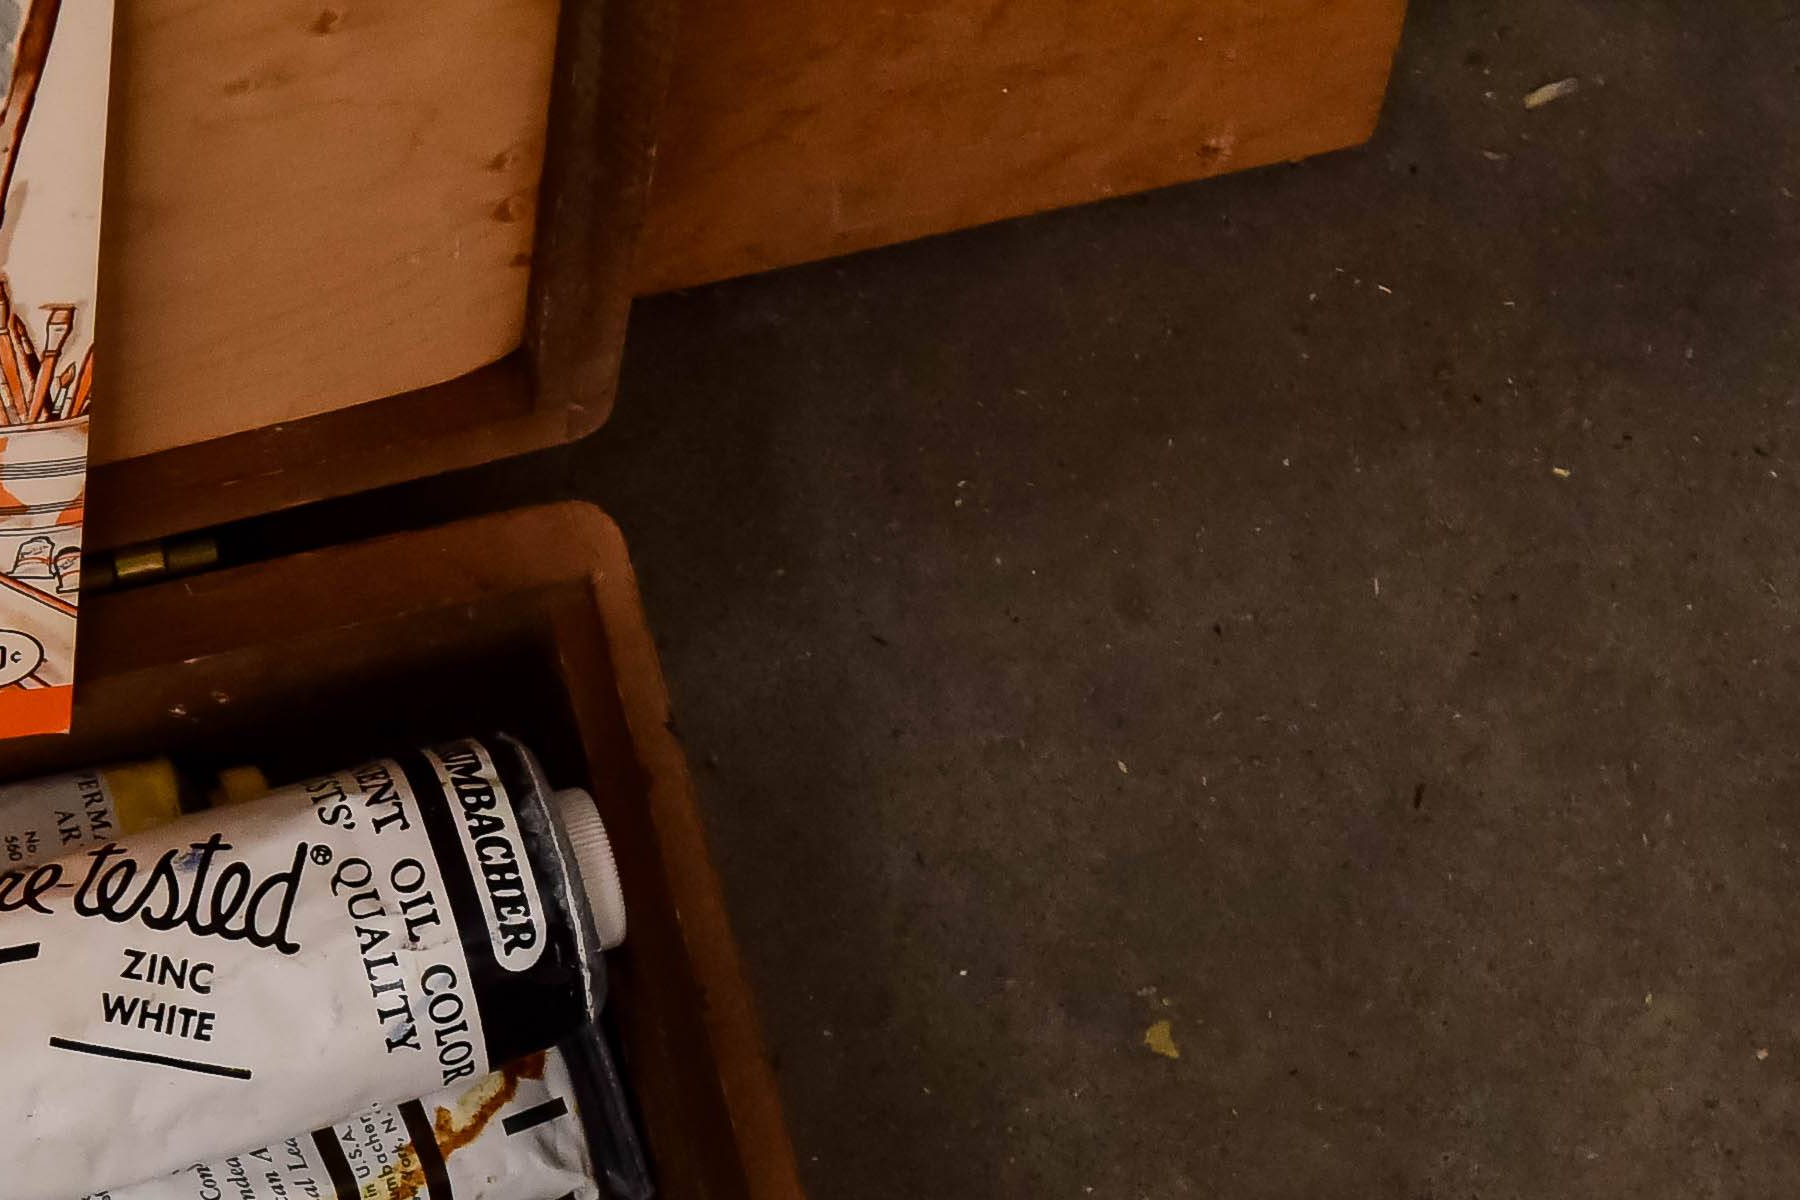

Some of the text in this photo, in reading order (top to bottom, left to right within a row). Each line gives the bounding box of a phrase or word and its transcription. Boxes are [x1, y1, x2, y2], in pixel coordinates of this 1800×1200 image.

[443, 752, 537, 957] UMBACHER
[102, 993, 216, 1042] WHITE
[120, 949, 215, 994] ZINC
[331, 857, 421, 1053] QUALITY
[390, 858, 475, 1086] OIL COLOR
